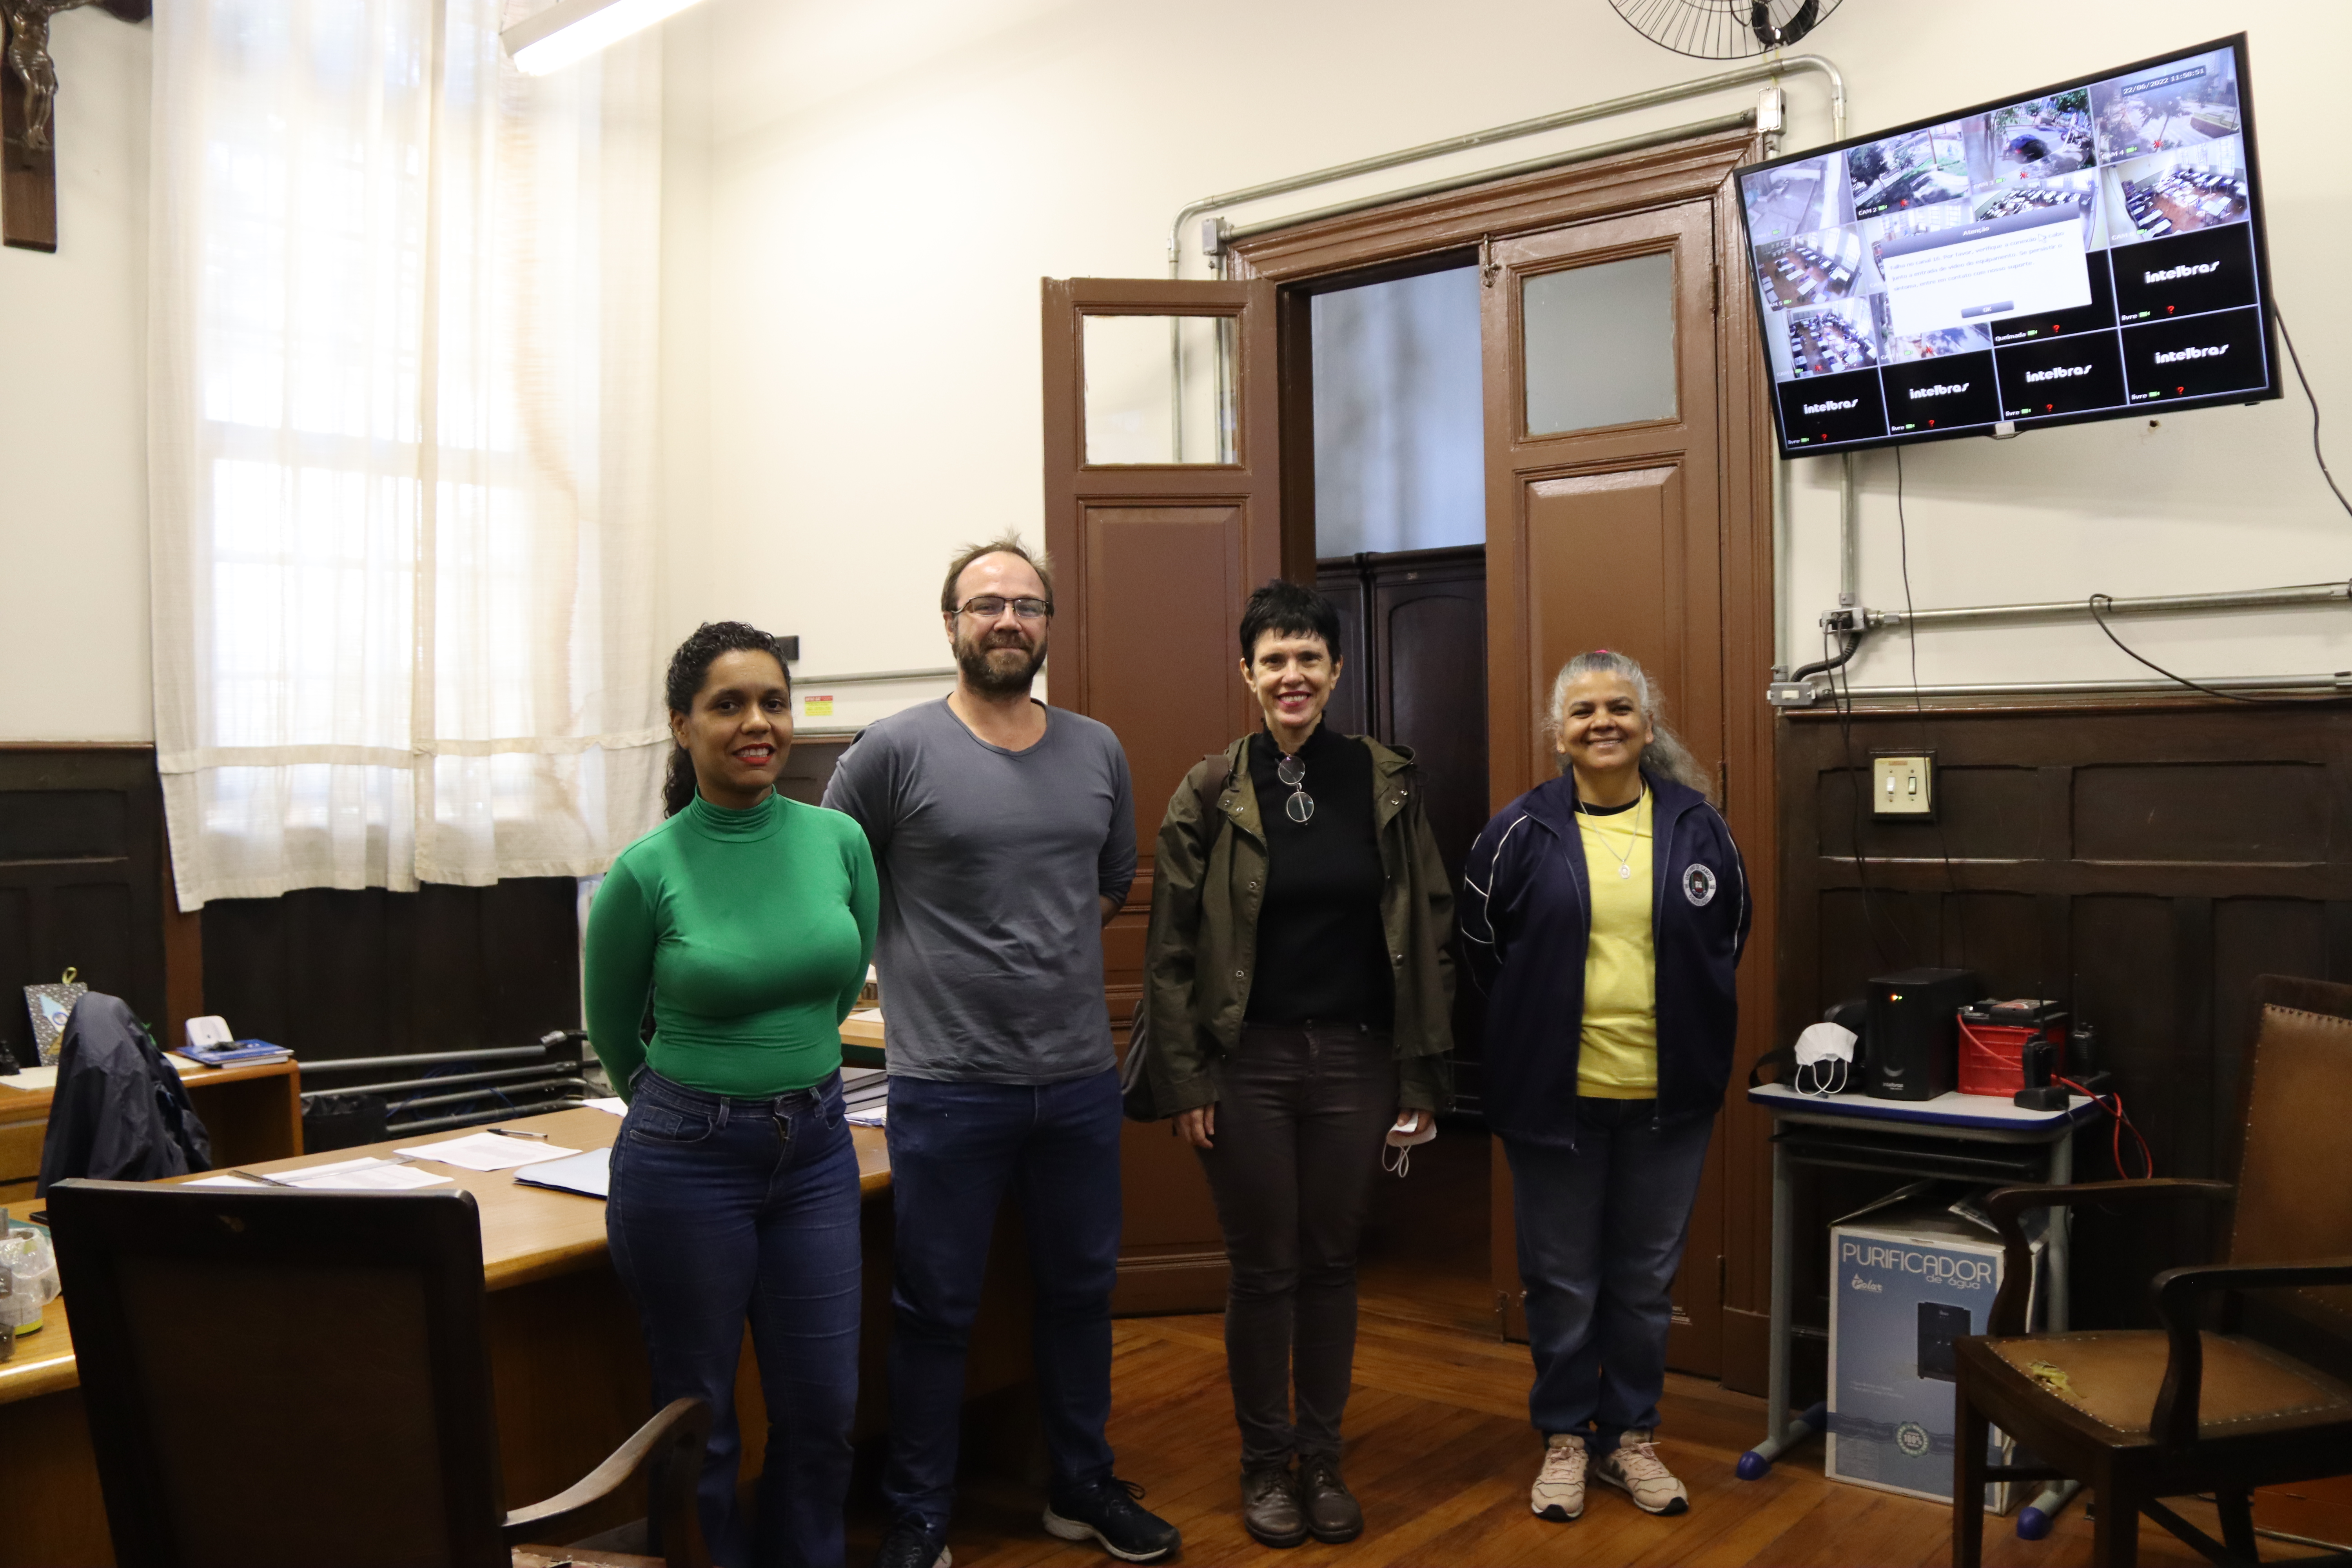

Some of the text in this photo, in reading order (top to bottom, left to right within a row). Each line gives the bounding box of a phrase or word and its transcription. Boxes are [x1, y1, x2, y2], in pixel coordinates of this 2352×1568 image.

[2123, 68, 2205, 94] 22/06/2022 11:58:51
[2102, 151, 2118, 159] CAM
[1963, 226, 1990, 236] Atenção
[1976, 244, 2002, 253] verifique
[2010, 237, 2037, 246] conexão
[1914, 267, 1937, 276] entrada
[1976, 253, 2018, 264] equipamento.
[2029, 244, 2056, 255] persistir
[1948, 272, 1972, 281] contato
[2007, 261, 2034, 270] suporte.
[2145, 261, 2220, 283] intelbras
[1995, 332, 2026, 342] Queimada
[2155, 344, 2229, 364] intelbras
[2026, 364, 2092, 383] intelbras
[1909, 382, 1969, 399] intelbras
[1804, 399, 1858, 414] intelbras
[1843, 1243, 1992, 1284] PURIFICADOR
[1926, 1275, 1980, 1289] de água
